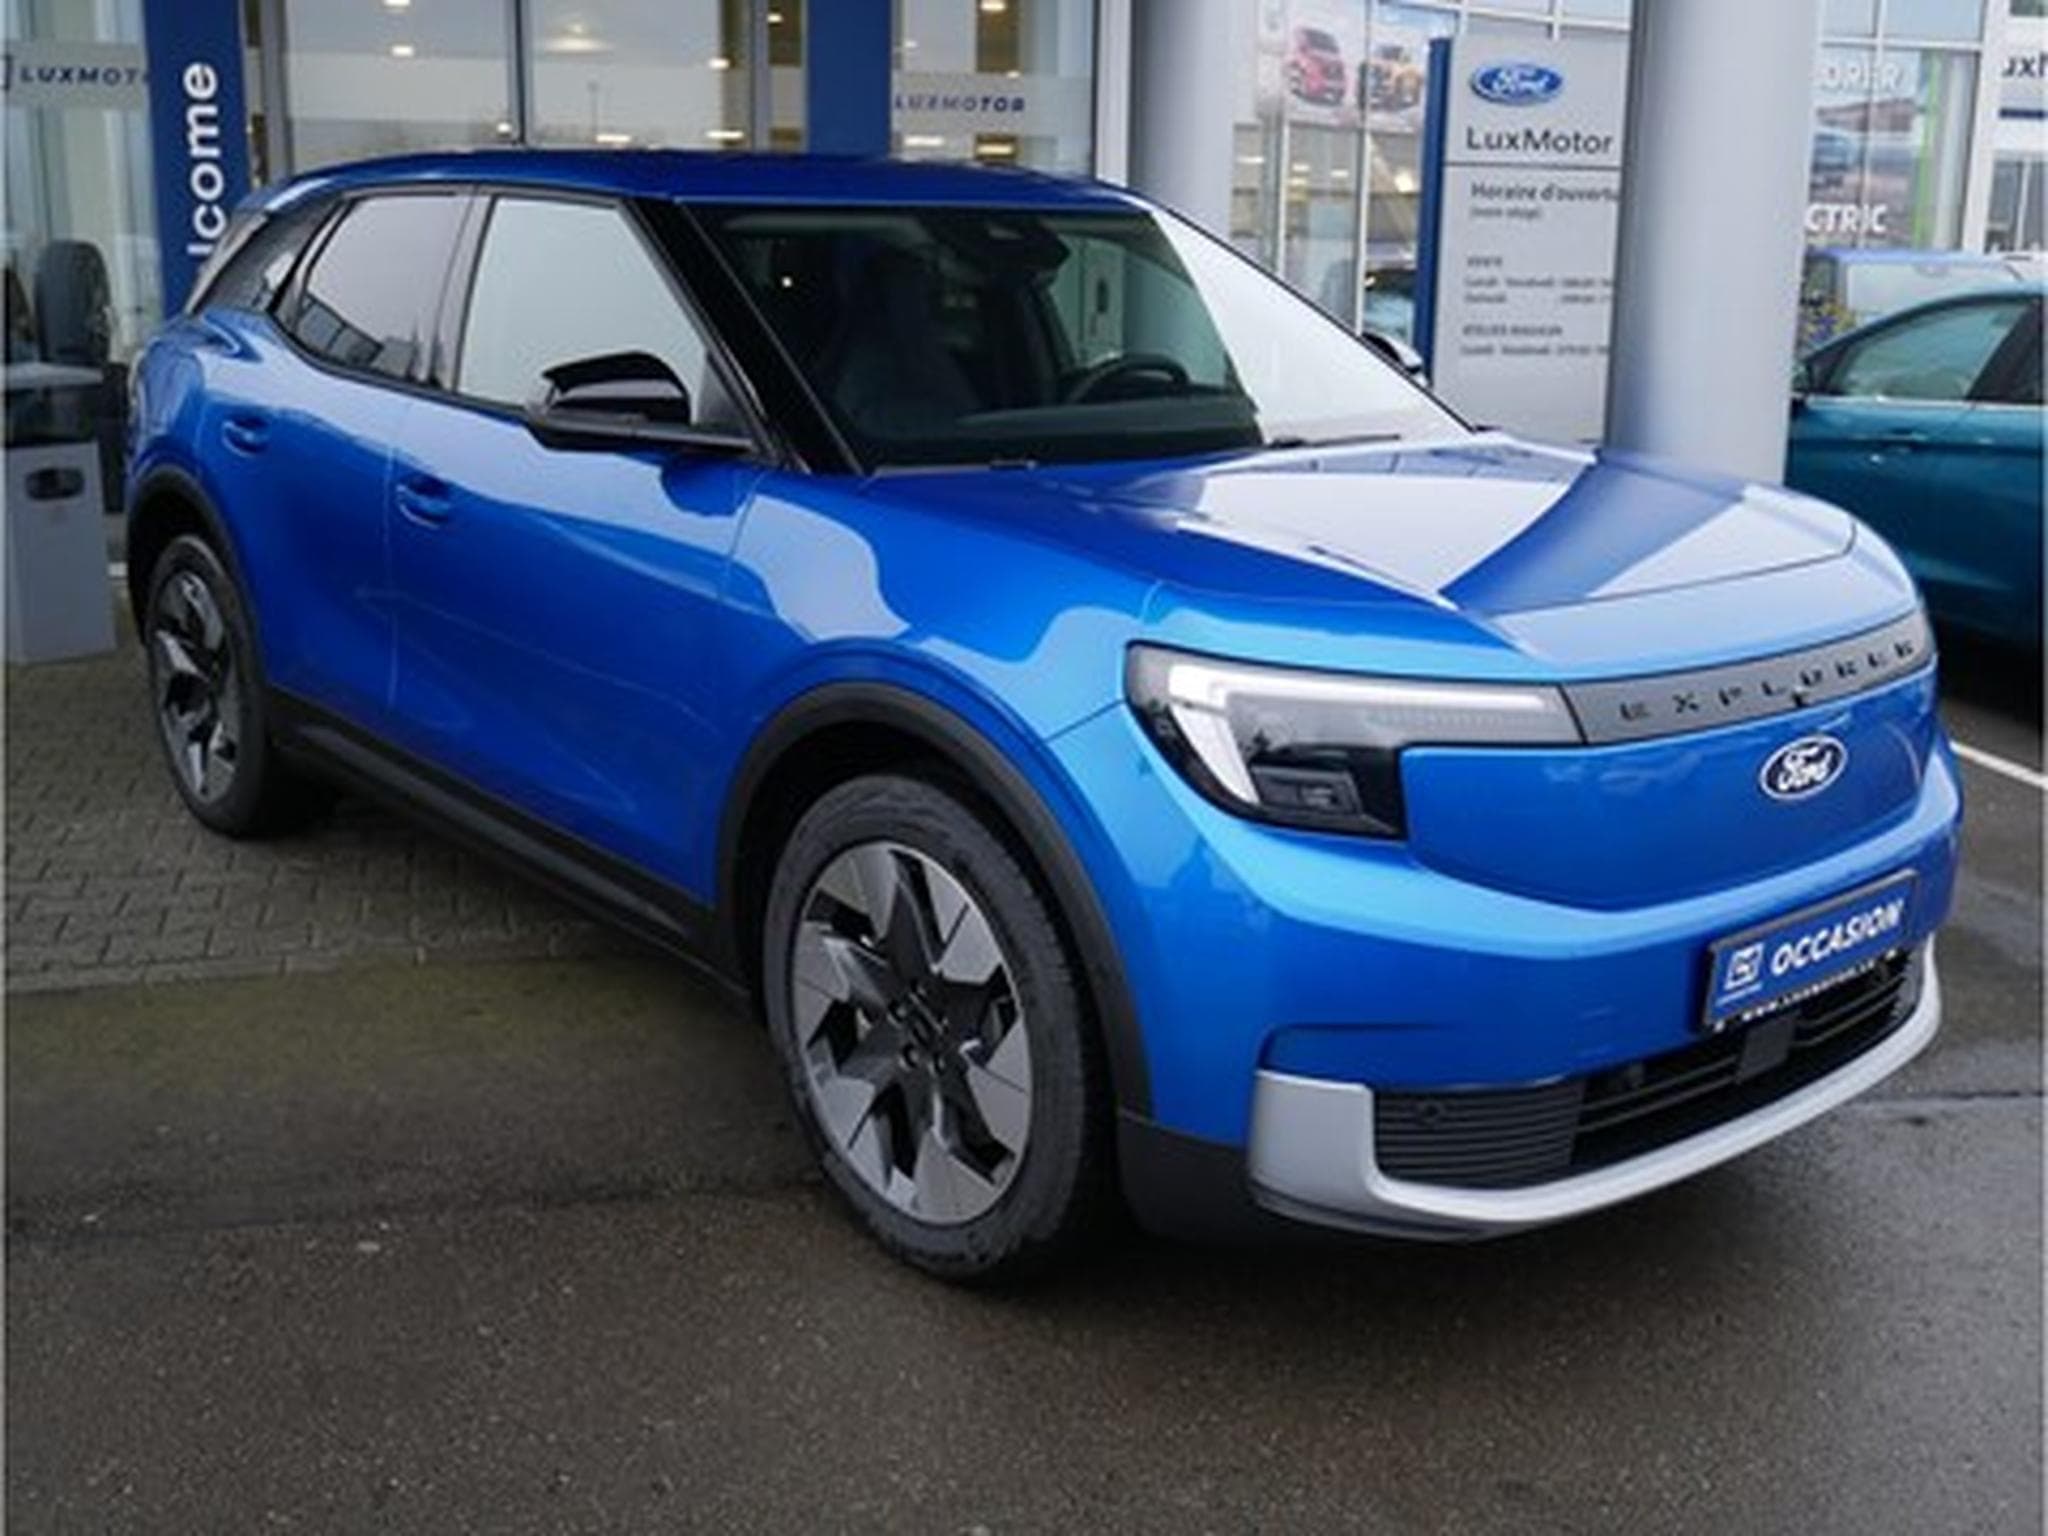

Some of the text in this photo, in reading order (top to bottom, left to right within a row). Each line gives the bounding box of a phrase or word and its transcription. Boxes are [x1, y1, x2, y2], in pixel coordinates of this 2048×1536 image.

[20, 66, 150, 86] LUXMOT
[1465, 126, 1614, 154] LuxMotor
[1471, 181, 1537, 200] Horaire
[1619, 639, 1915, 721] EXPLORER
[1770, 897, 1906, 977] OCCASION
